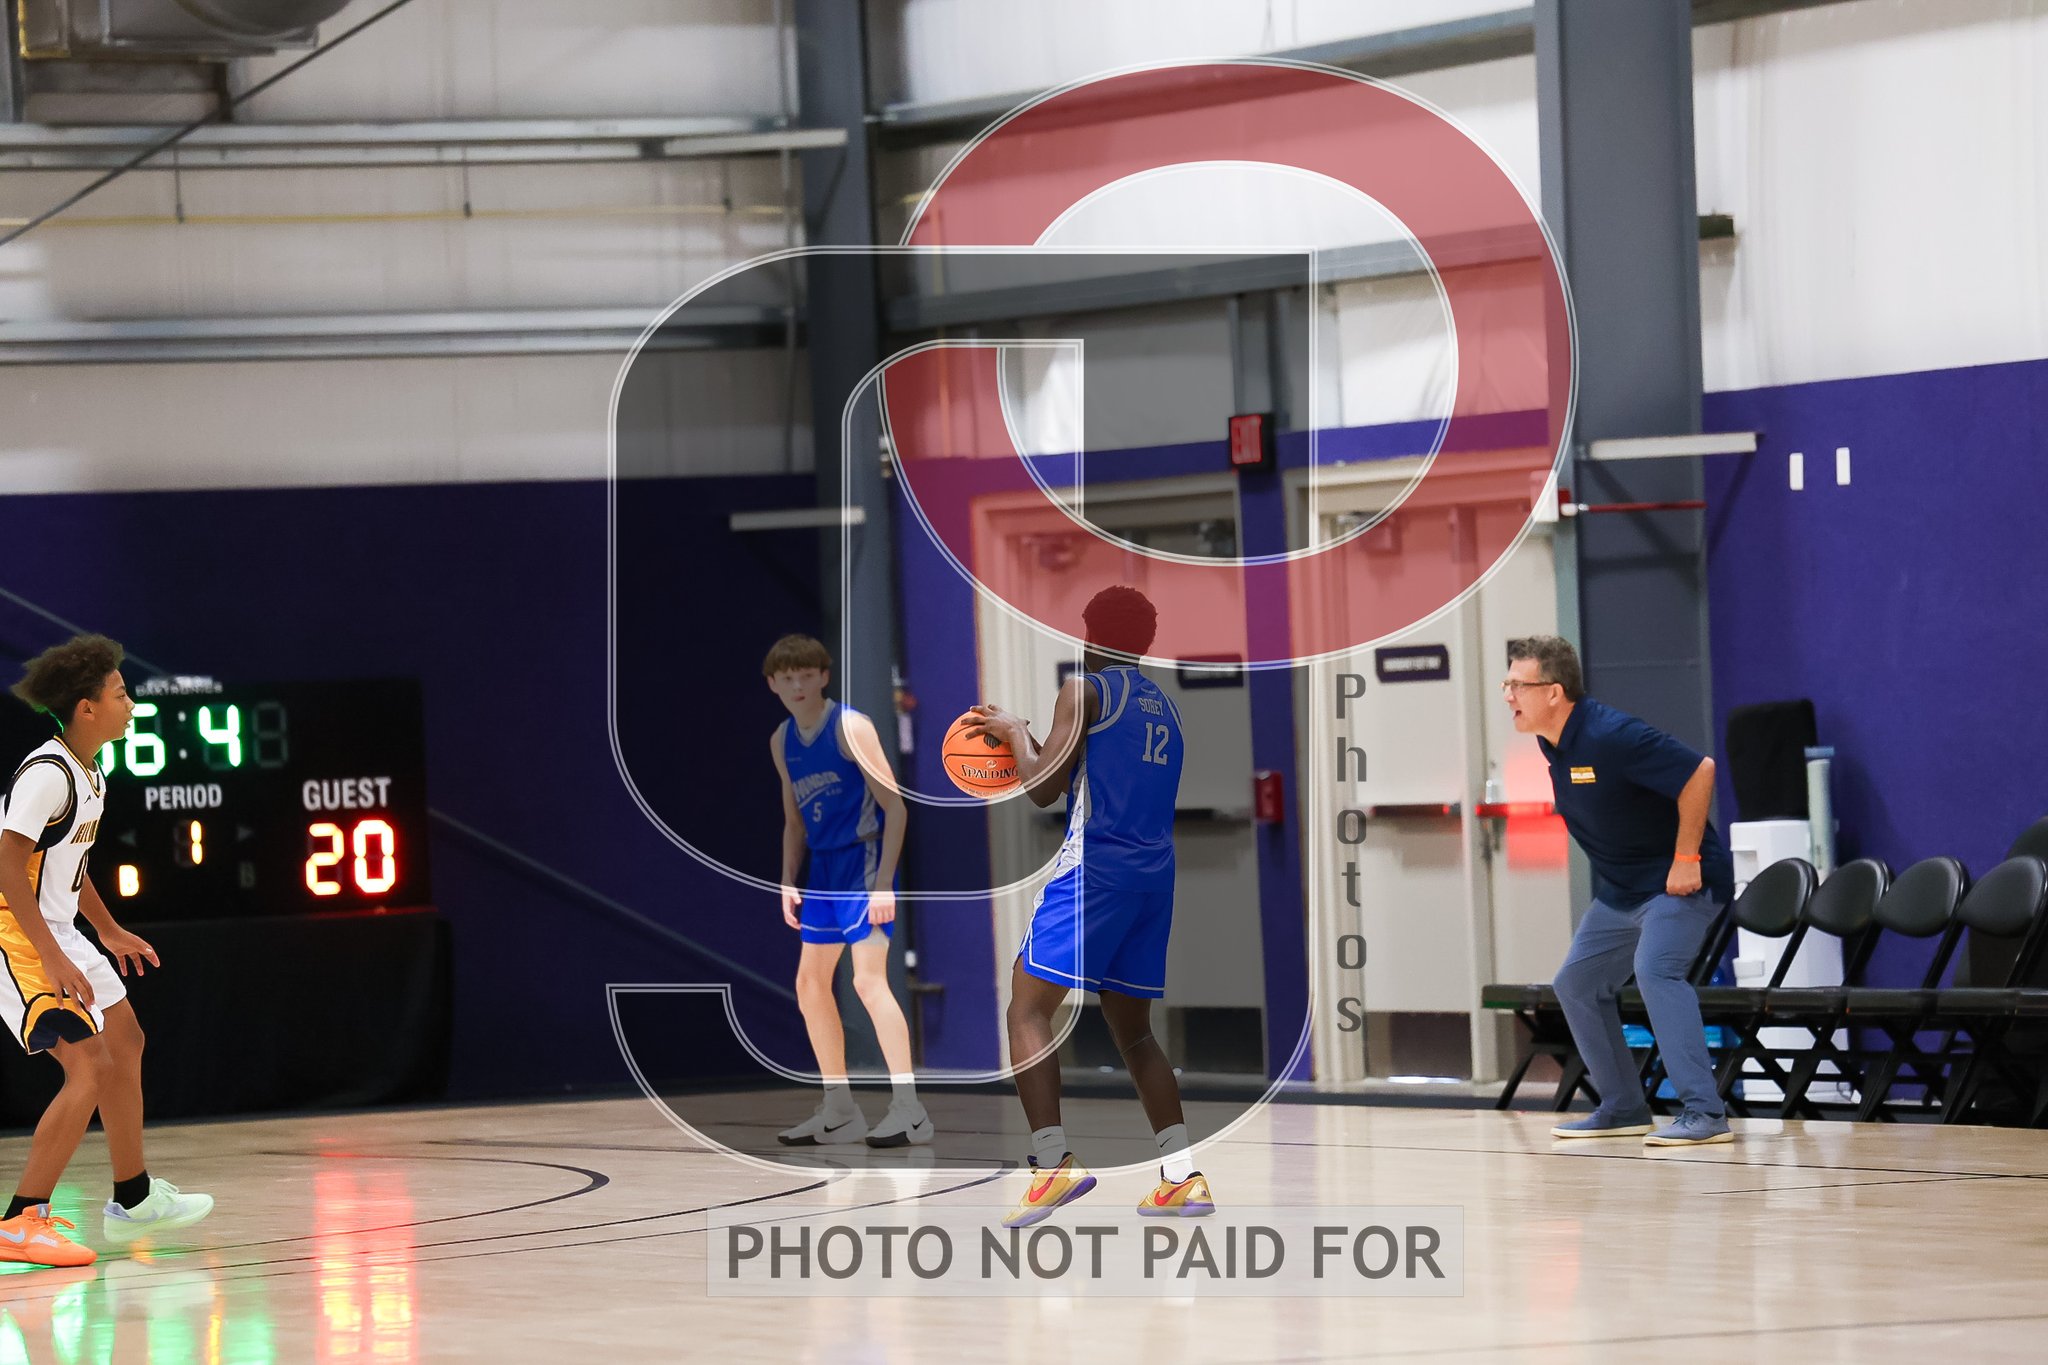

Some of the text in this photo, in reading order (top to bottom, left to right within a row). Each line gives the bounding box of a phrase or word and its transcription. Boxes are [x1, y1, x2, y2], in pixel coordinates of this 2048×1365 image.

[1138, 697, 1164, 717] SOREY
[1142, 721, 1169, 766] 12
[145, 783, 222, 811] PERIOD
[302, 777, 392, 811] GUEST
[813, 801, 823, 823] 5
[190, 819, 204, 865] 1
[305, 818, 396, 896] 20
